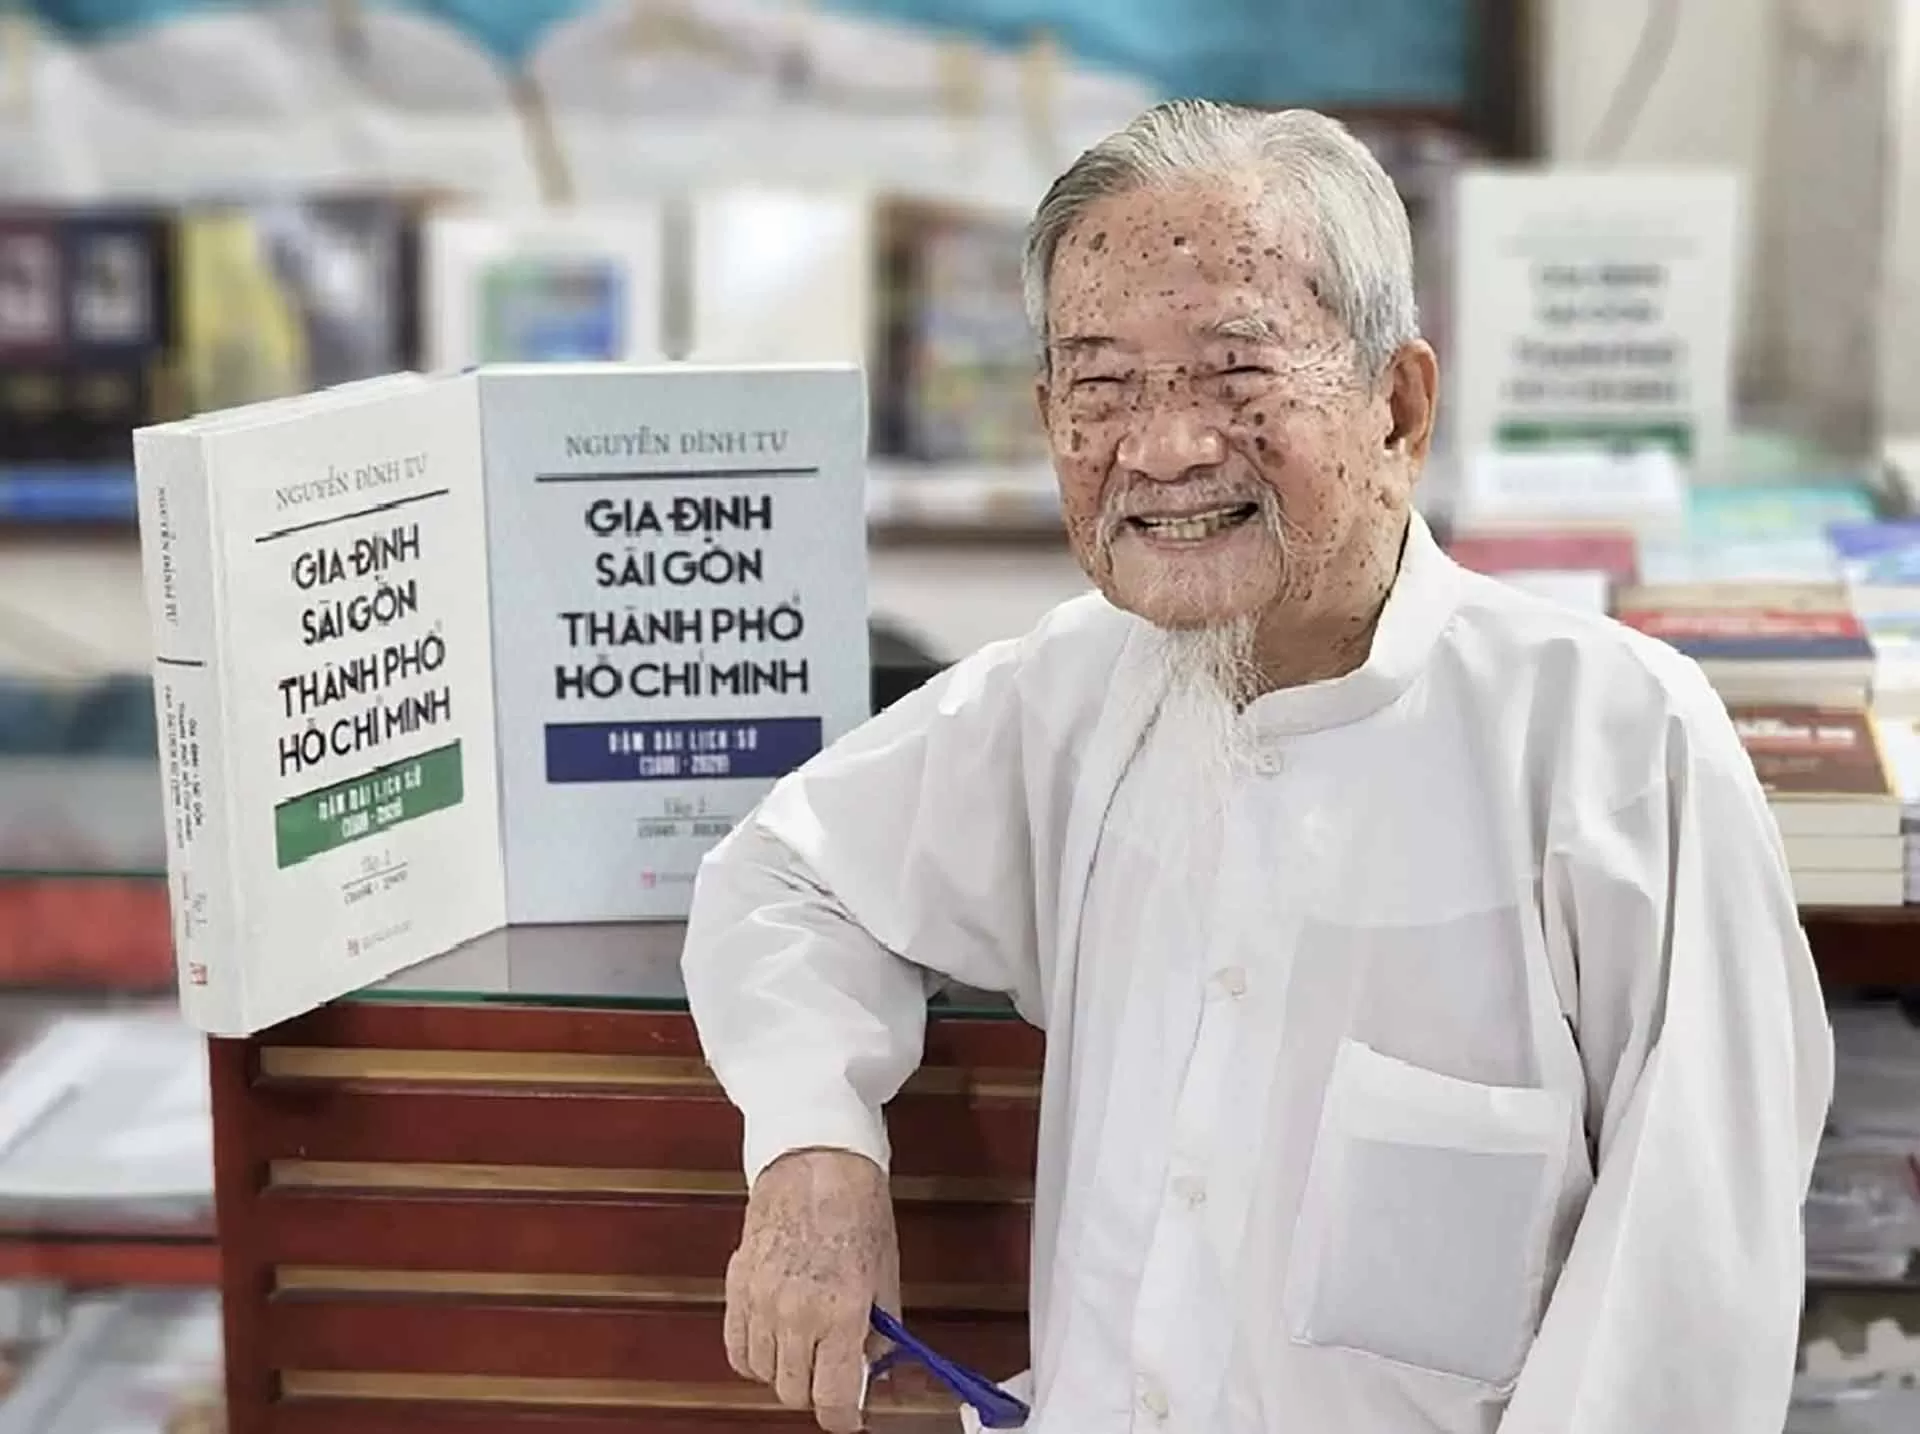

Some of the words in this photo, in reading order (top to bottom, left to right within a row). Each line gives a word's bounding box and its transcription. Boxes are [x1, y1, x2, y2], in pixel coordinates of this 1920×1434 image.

[585, 498, 663, 536] GIA
[667, 495, 773, 543] ĐỊNH
[292, 548, 346, 590] GIA
[348, 523, 420, 581] ĐỊNH
[596, 546, 657, 587] SÀI
[663, 545, 764, 584] GÒN
[302, 599, 344, 646] SÀI
[348, 578, 418, 632] GÒN
[558, 605, 703, 647] THÀNH
[711, 594, 804, 643] PHỐ
[278, 654, 379, 718] THÀNH
[383, 620, 446, 687] PHỐ
[555, 654, 623, 699] HỒ
[630, 649, 704, 697] CHÍ
[710, 658, 808, 697] MINH
[279, 718, 327, 777] HỒ
[331, 694, 379, 756] CHÍ
[385, 686, 450, 740] MINH
